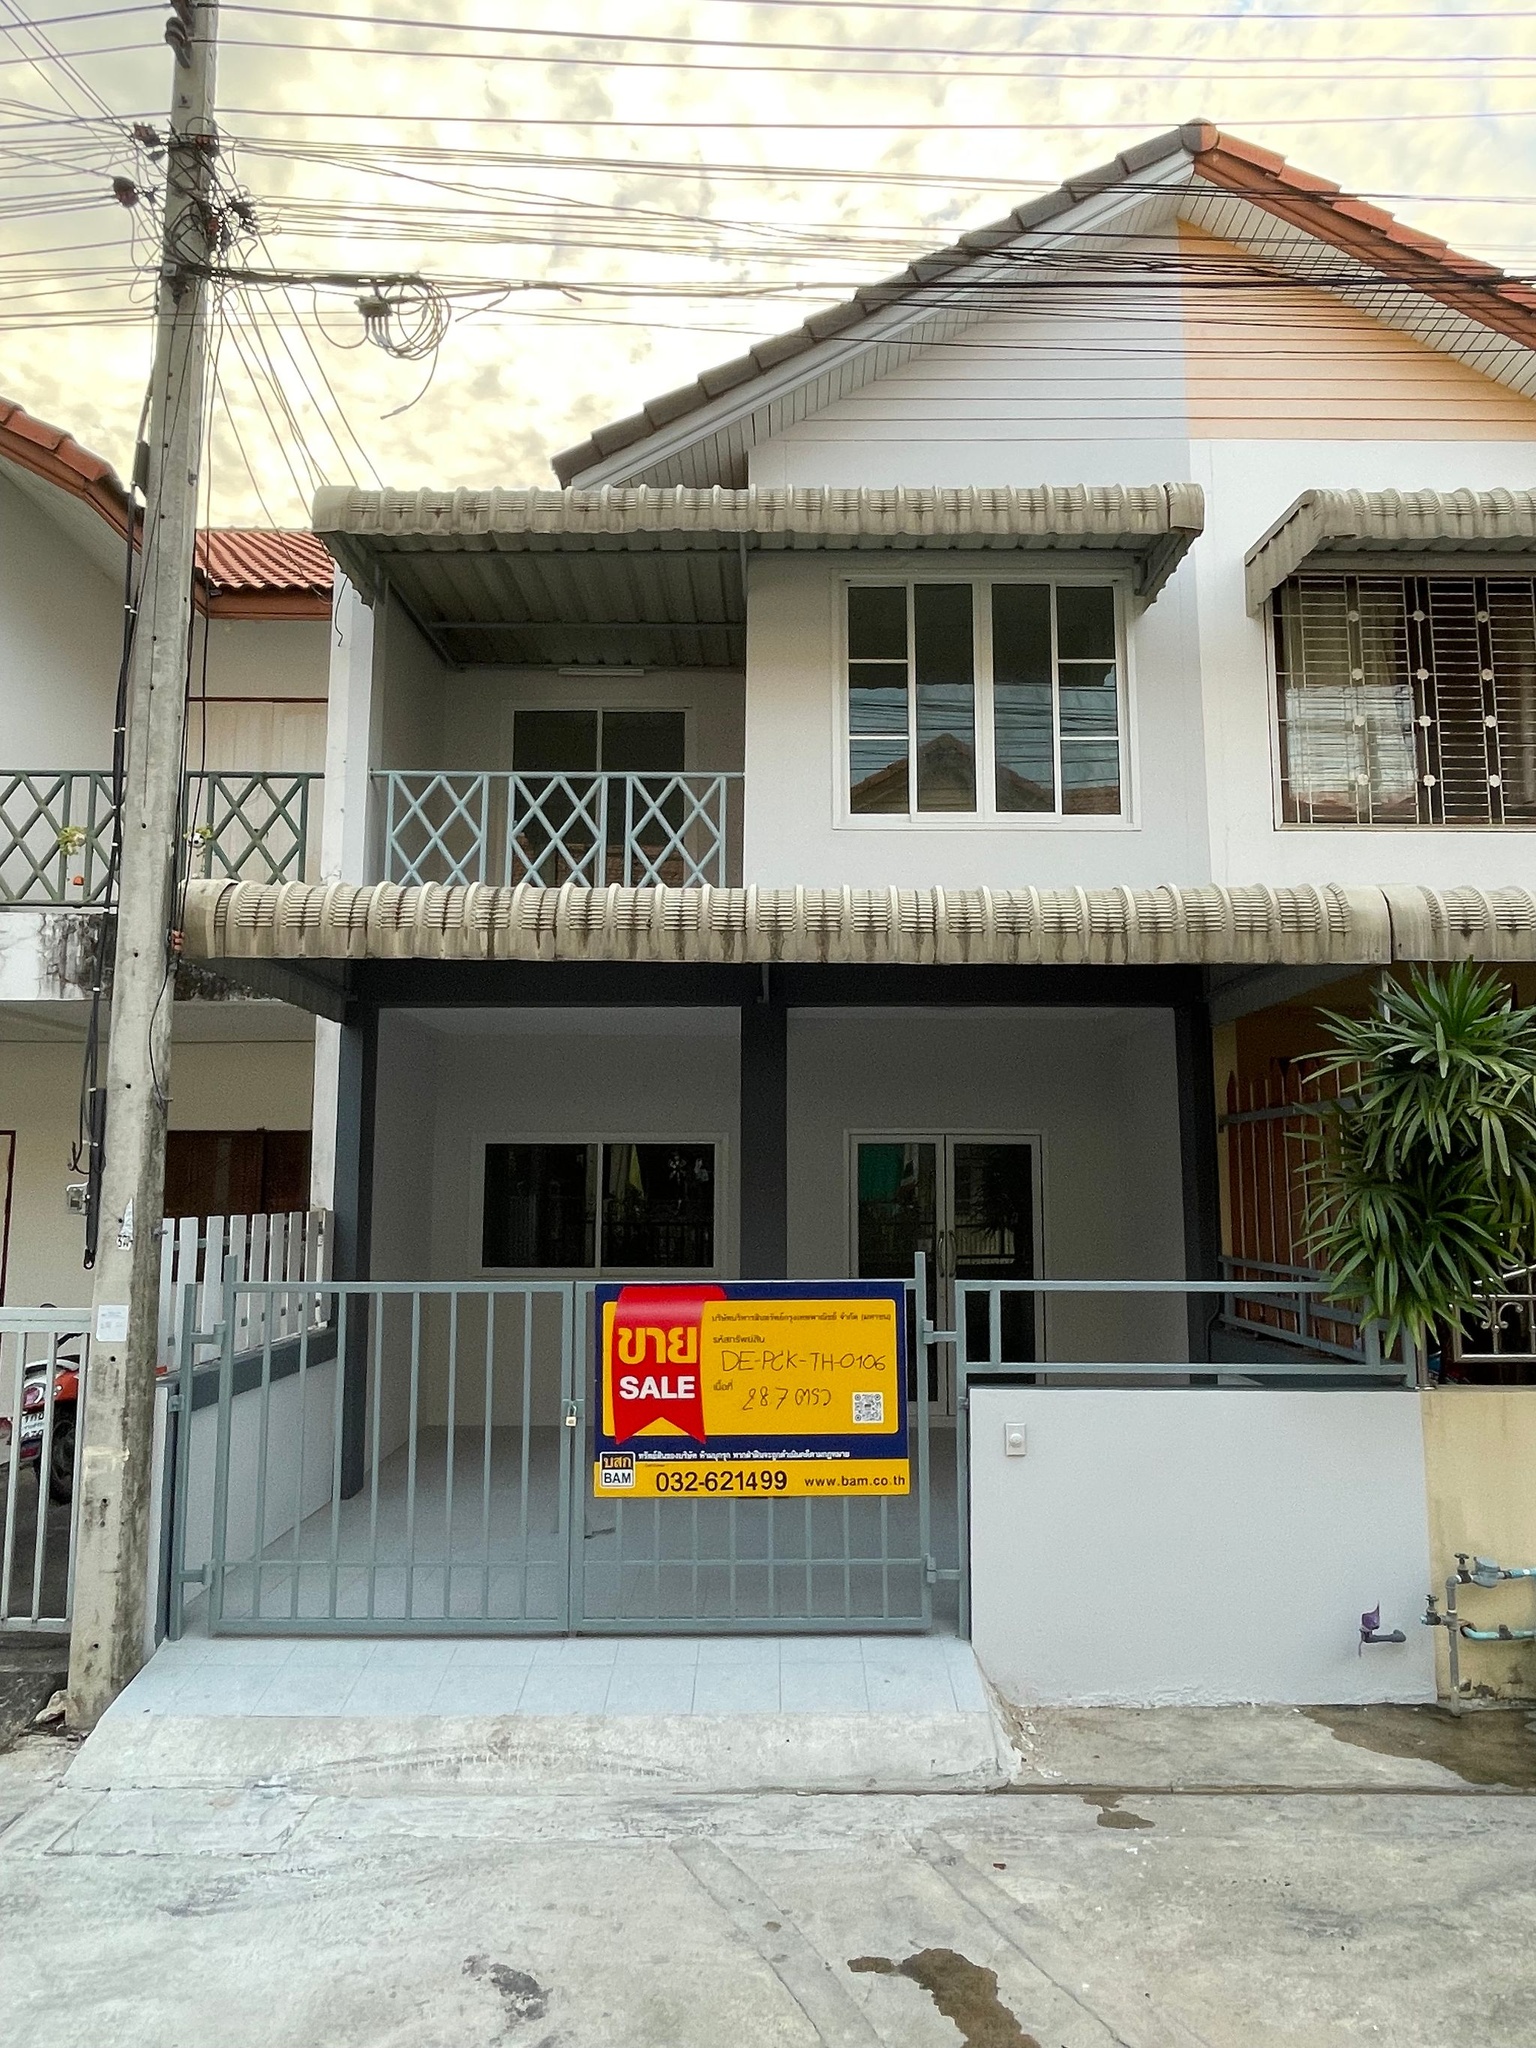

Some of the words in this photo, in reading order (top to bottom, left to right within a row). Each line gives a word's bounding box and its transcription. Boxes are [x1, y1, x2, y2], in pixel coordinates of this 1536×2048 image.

[618, 1327, 698, 1364] ขาย
[619, 1376, 696, 1400] SALE
[603, 1456, 632, 1468] บสก
[604, 1472, 632, 1484] BAM
[656, 1470, 788, 1492] 032-621499
[804, 1474, 906, 1488] www.bam.co.th
